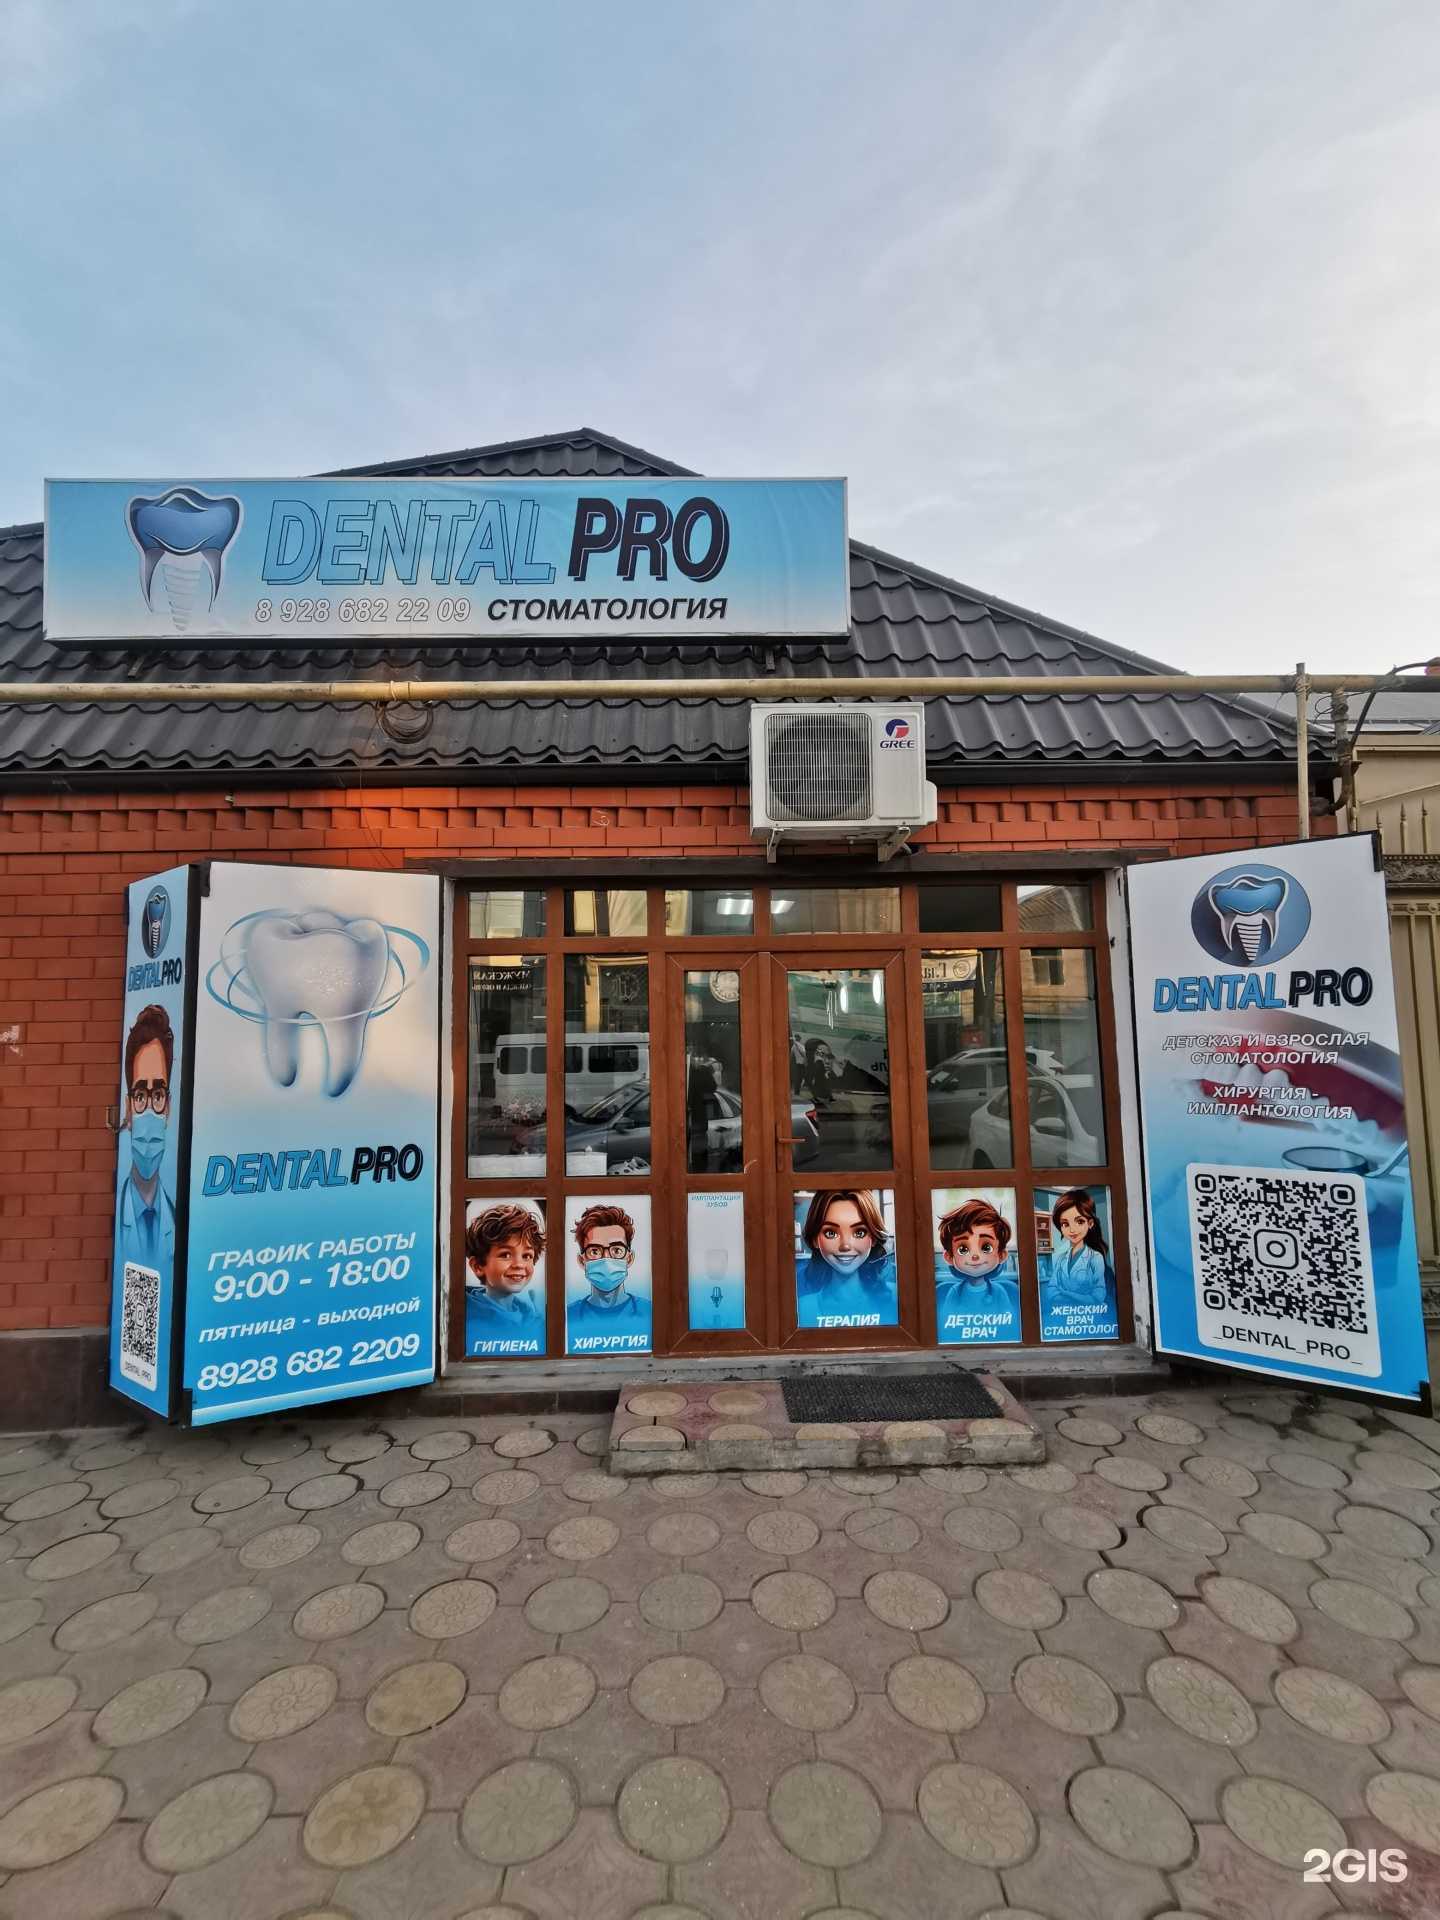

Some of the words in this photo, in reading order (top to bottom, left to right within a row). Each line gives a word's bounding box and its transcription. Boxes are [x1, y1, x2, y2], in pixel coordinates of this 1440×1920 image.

[262, 499, 556, 585] DENTAL
[567, 496, 730, 583] PRO
[255, 598, 272, 623] 8
[281, 598, 331, 623] 928
[338, 598, 388, 623] 682
[396, 598, 430, 623] 22
[437, 598, 471, 623] 09
[487, 598, 728, 621] СТОМАТОЛОГИЯ
[880, 740, 915, 749] GREE
[128, 962, 161, 992] DENTAL
[161, 957, 182, 986] PRO
[1153, 972, 1286, 1013] DENTAL
[1288, 967, 1373, 1008] PRO
[1163, 1034, 1243, 1051] ДЕТСКАЯ
[1246, 1034, 1261, 1048] И
[1265, 1032, 1370, 1047] ВЗРОСЛАЯ
[1191, 1050, 1339, 1065] СТОМАТОЛОГИЯ
[1213, 1085, 1307, 1100] ХИРУРГИЯ
[1187, 1102, 1353, 1119] ИМПЛАНТОЛОГИЯ
[202, 1148, 348, 1198] DENTAL
[350, 1143, 424, 1185] PRO
[207, 1242, 315, 1271] ГРАФИК
[318, 1232, 417, 1259] РАБОТЫ
[212, 1269, 290, 1303] 9:00
[326, 1255, 410, 1289] 18:00
[1050, 1303, 1109, 1316] ЖЕНСКИЙ
[816, 1313, 880, 1328] ТЕРАПИЯ
[945, 1311, 1012, 1328] ДЕТСКИЙ
[1066, 1315, 1095, 1325] ВРАЧ
[198, 1316, 297, 1344] пятница
[961, 1326, 998, 1339] ВРАЧ
[1043, 1323, 1119, 1336] СТАМОТОЛОГ
[474, 1340, 539, 1353] ГИГИЕНА
[574, 1334, 648, 1350] ХИРУРГИЯ
[197, 1356, 278, 1391] 8928
[286, 1346, 343, 1376] 682
[349, 1333, 421, 1366] 2209
